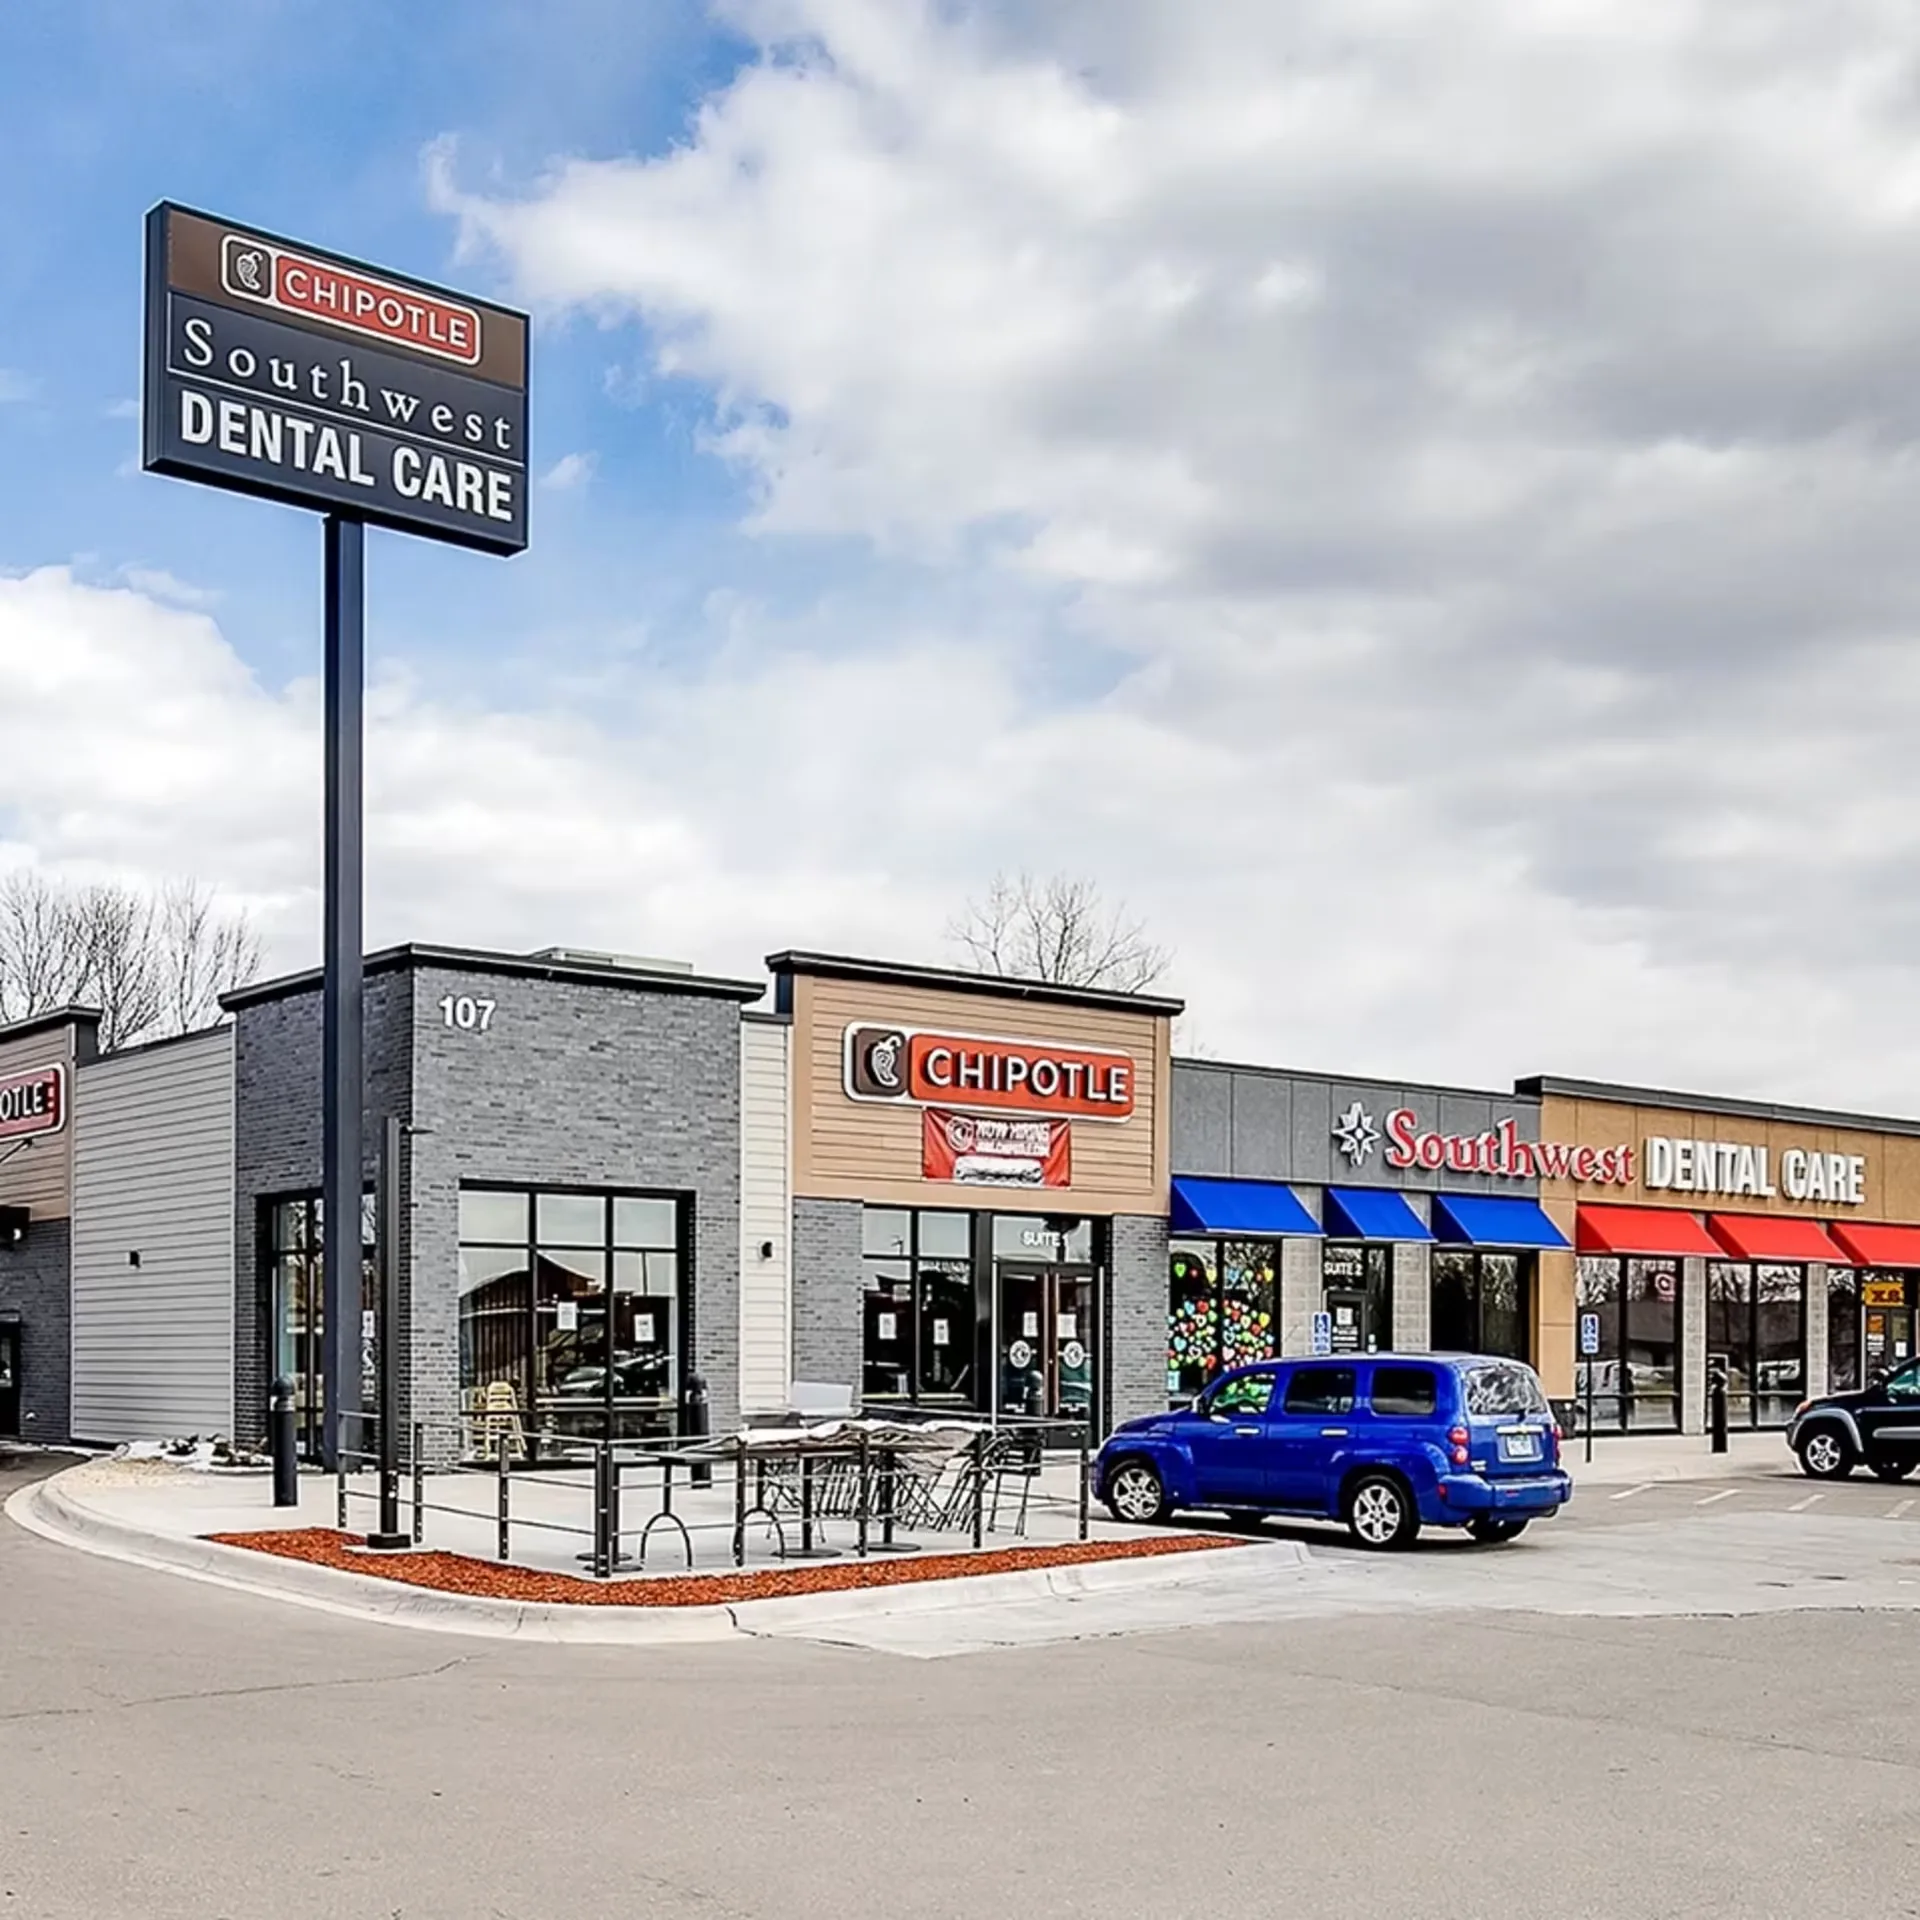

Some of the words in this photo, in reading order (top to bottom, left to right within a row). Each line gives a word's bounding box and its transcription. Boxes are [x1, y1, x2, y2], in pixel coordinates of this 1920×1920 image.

[284, 269, 470, 349] CHIPOTLE
[183, 318, 512, 450] Southwest
[181, 389, 375, 487] DENTAL
[393, 446, 513, 522] CARE
[438, 994, 496, 1030] 107
[926, 1047, 1130, 1102] CHIPOTLE
[1385, 1108, 1637, 1184] Southwest
[1645, 1135, 1777, 1197] DENTAL
[1781, 1149, 1866, 1204] CARE
[1023, 1231, 1061, 1247] SUITE
[1323, 1261, 1354, 1276] SUITE
[1355, 1262, 1363, 1277] 2
